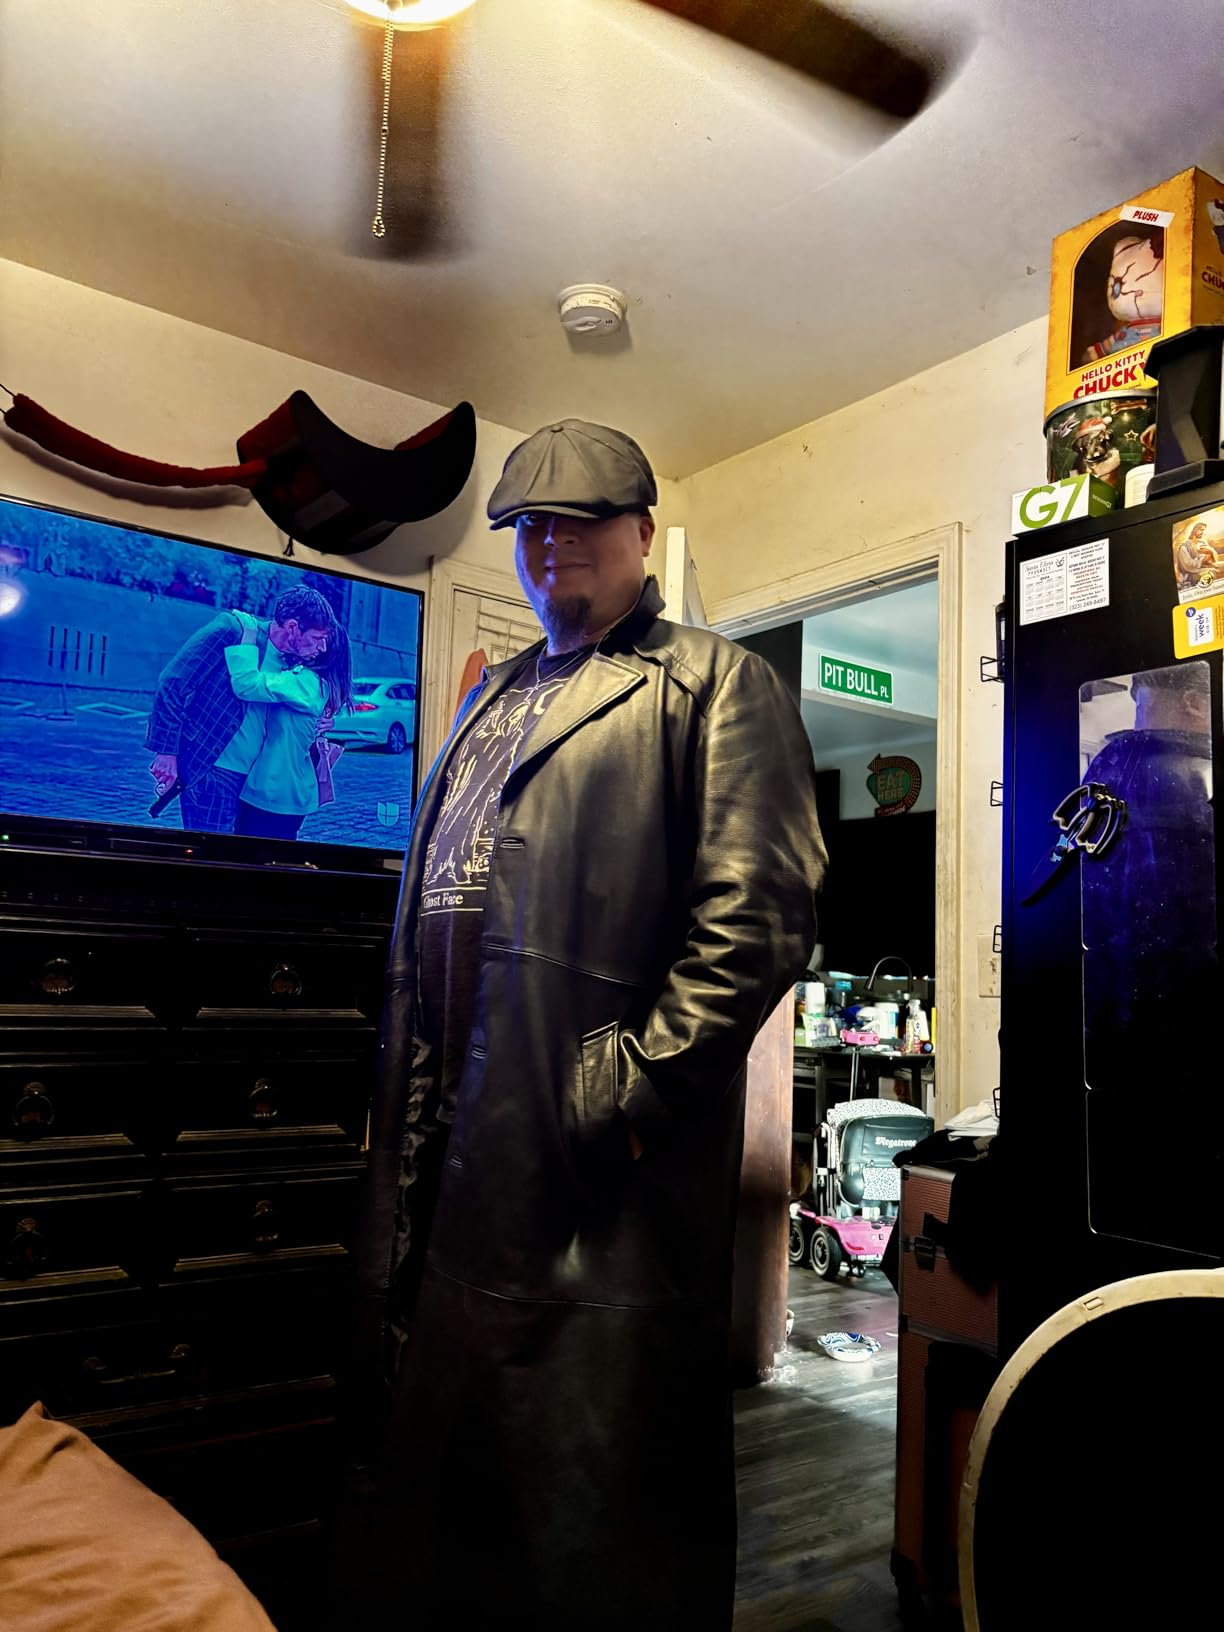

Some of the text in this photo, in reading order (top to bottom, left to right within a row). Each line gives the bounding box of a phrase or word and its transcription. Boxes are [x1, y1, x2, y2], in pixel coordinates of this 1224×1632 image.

[1132, 210, 1160, 223] PLUSH
[1081, 349, 1146, 382] HELLO KITTY
[1019, 473, 1087, 528] G7
[1195, 613, 1206, 638] week
[824, 662, 889, 698] PIT BULL PL
[877, 770, 905, 790] EAT
[877, 787, 904, 801] HERE
[442, 892, 464, 905] Face
